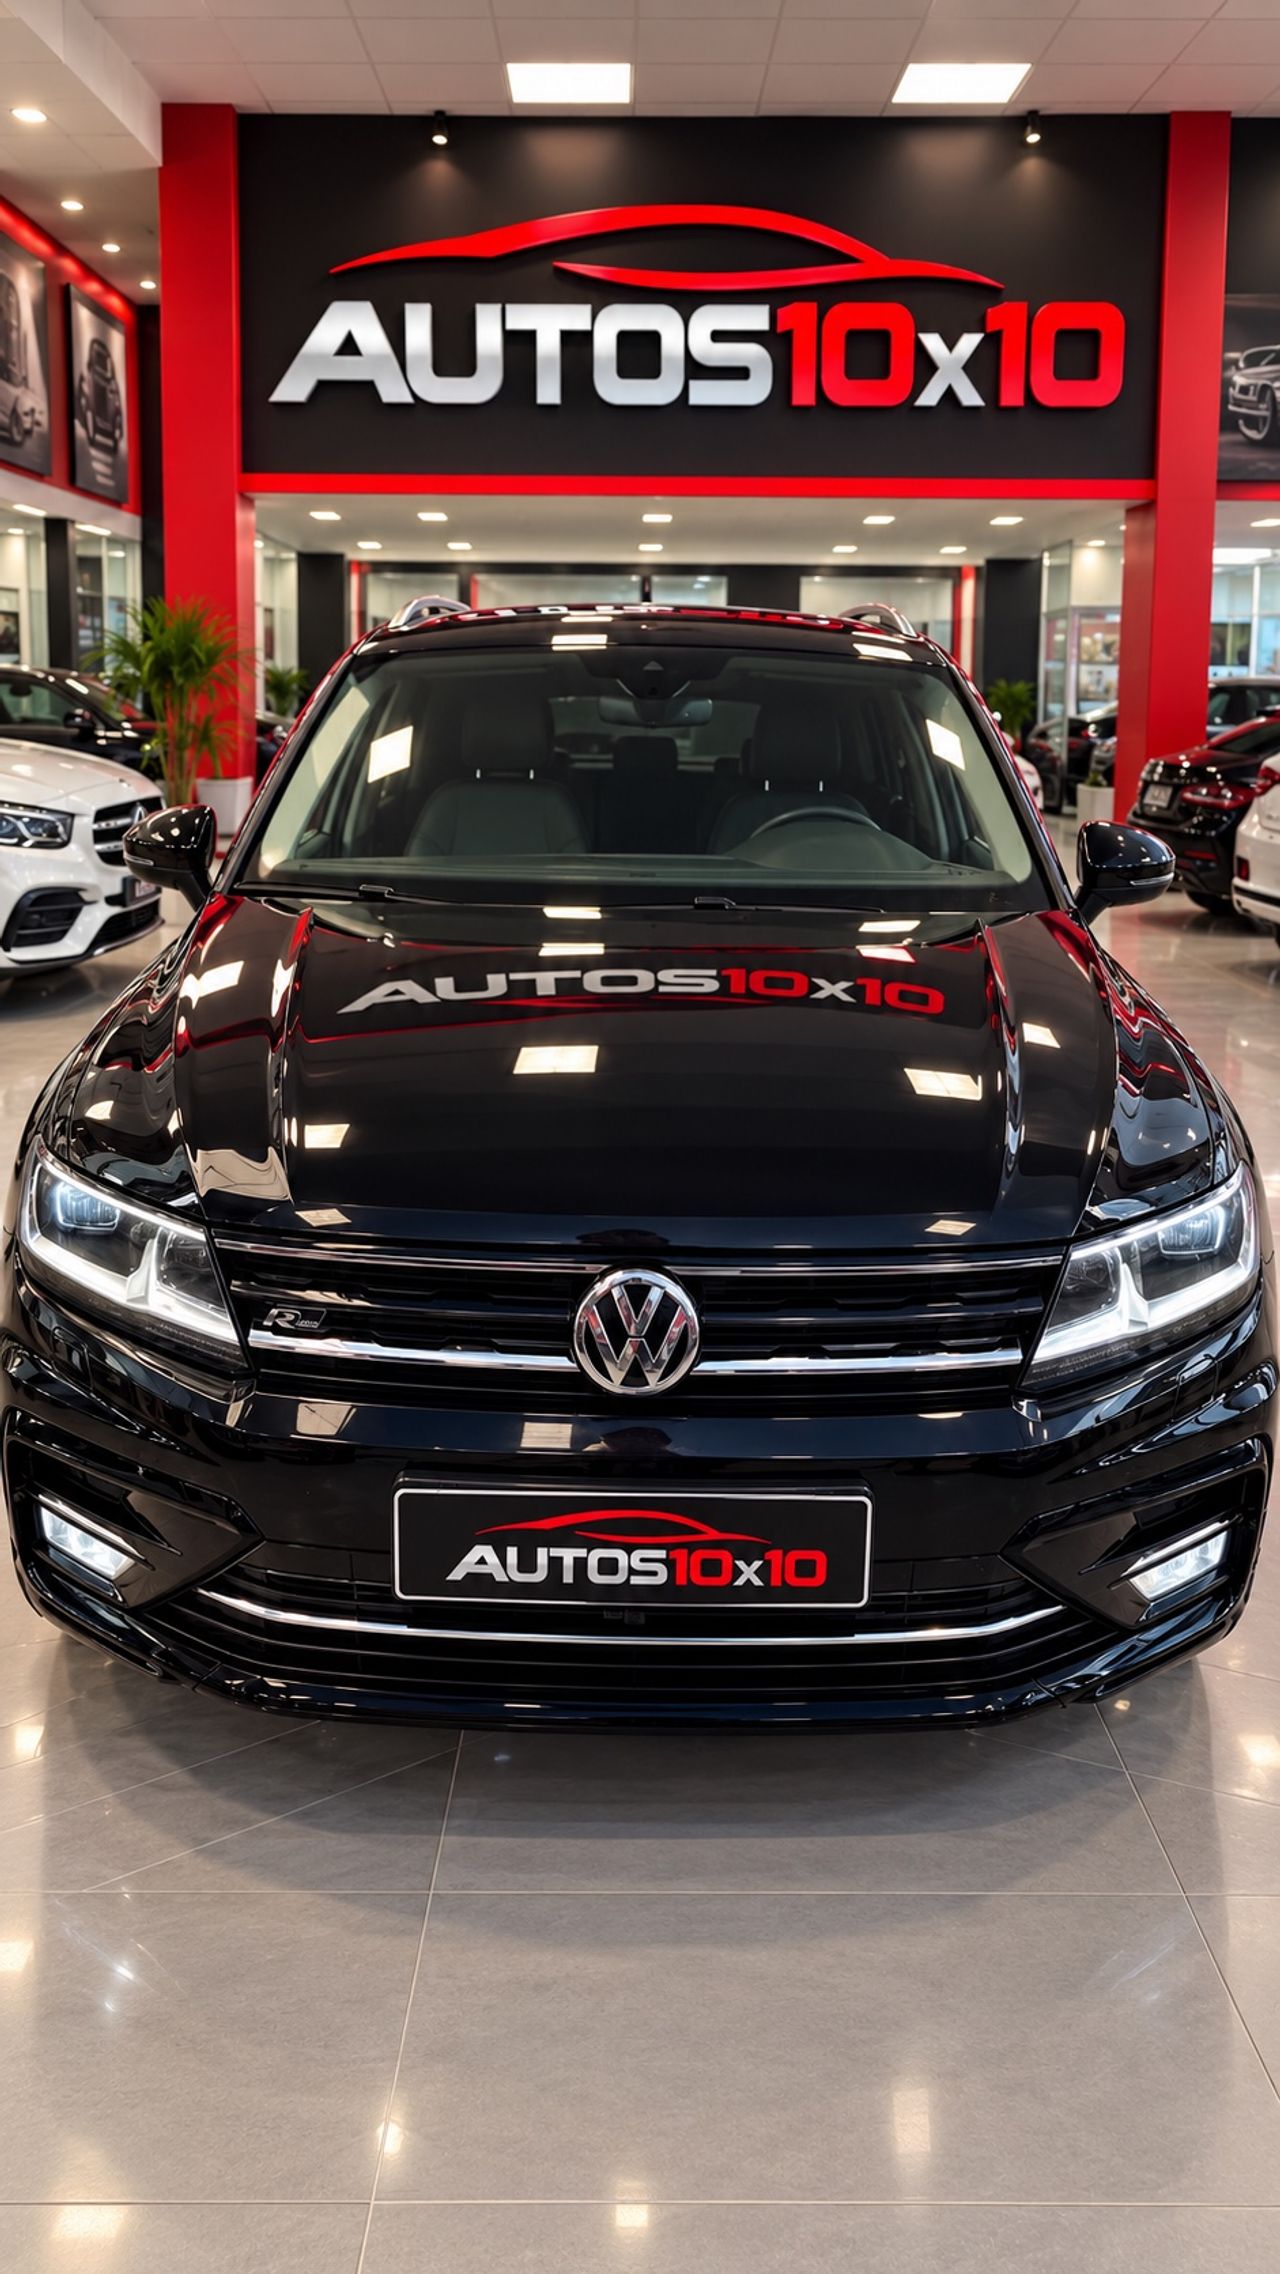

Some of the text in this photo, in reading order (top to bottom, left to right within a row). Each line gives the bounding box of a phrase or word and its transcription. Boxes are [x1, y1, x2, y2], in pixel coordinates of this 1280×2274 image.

[269, 300, 1126, 409] AUTOS10x10
[337, 968, 945, 1015] AUTOS10x10
[446, 1545, 828, 1587] AUTOS10x10
